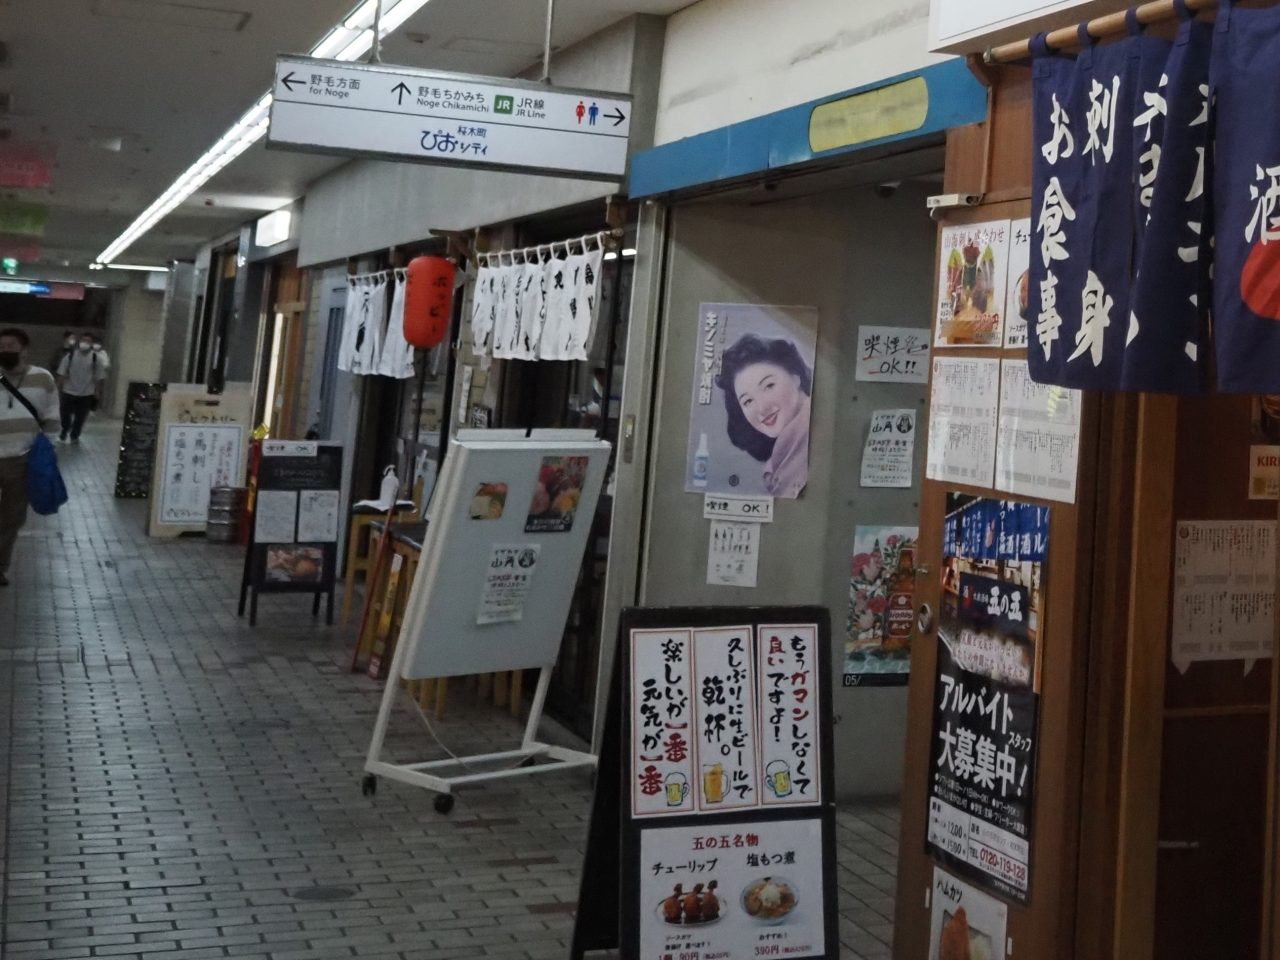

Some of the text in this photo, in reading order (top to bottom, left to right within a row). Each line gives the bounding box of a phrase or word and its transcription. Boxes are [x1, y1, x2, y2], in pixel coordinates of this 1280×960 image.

[310, 73, 361, 91] 野毛方面
[309, 86, 350, 100] for Noge
[417, 85, 486, 104] 野毛ちかみち
[416, 97, 490, 114] Noge Chikamichi
[496, 99, 512, 111] JR
[516, 96, 545, 110] JR線
[515, 109, 547, 120] JR Line
[458, 124, 487, 139] 桜木町
[1035, 92, 1077, 362] お食事
[1066, 74, 1121, 368] 刺身
[725, 638, 753, 799] 久しぶりに生ビールで
[790, 636, 811, 796] もうガマンしなくて
[940, 674, 1032, 752] アルバイト スタッフ
[692, 833, 759, 851] 五の五名物
[652, 851, 796, 876] チューリップ 塩もつ煮
